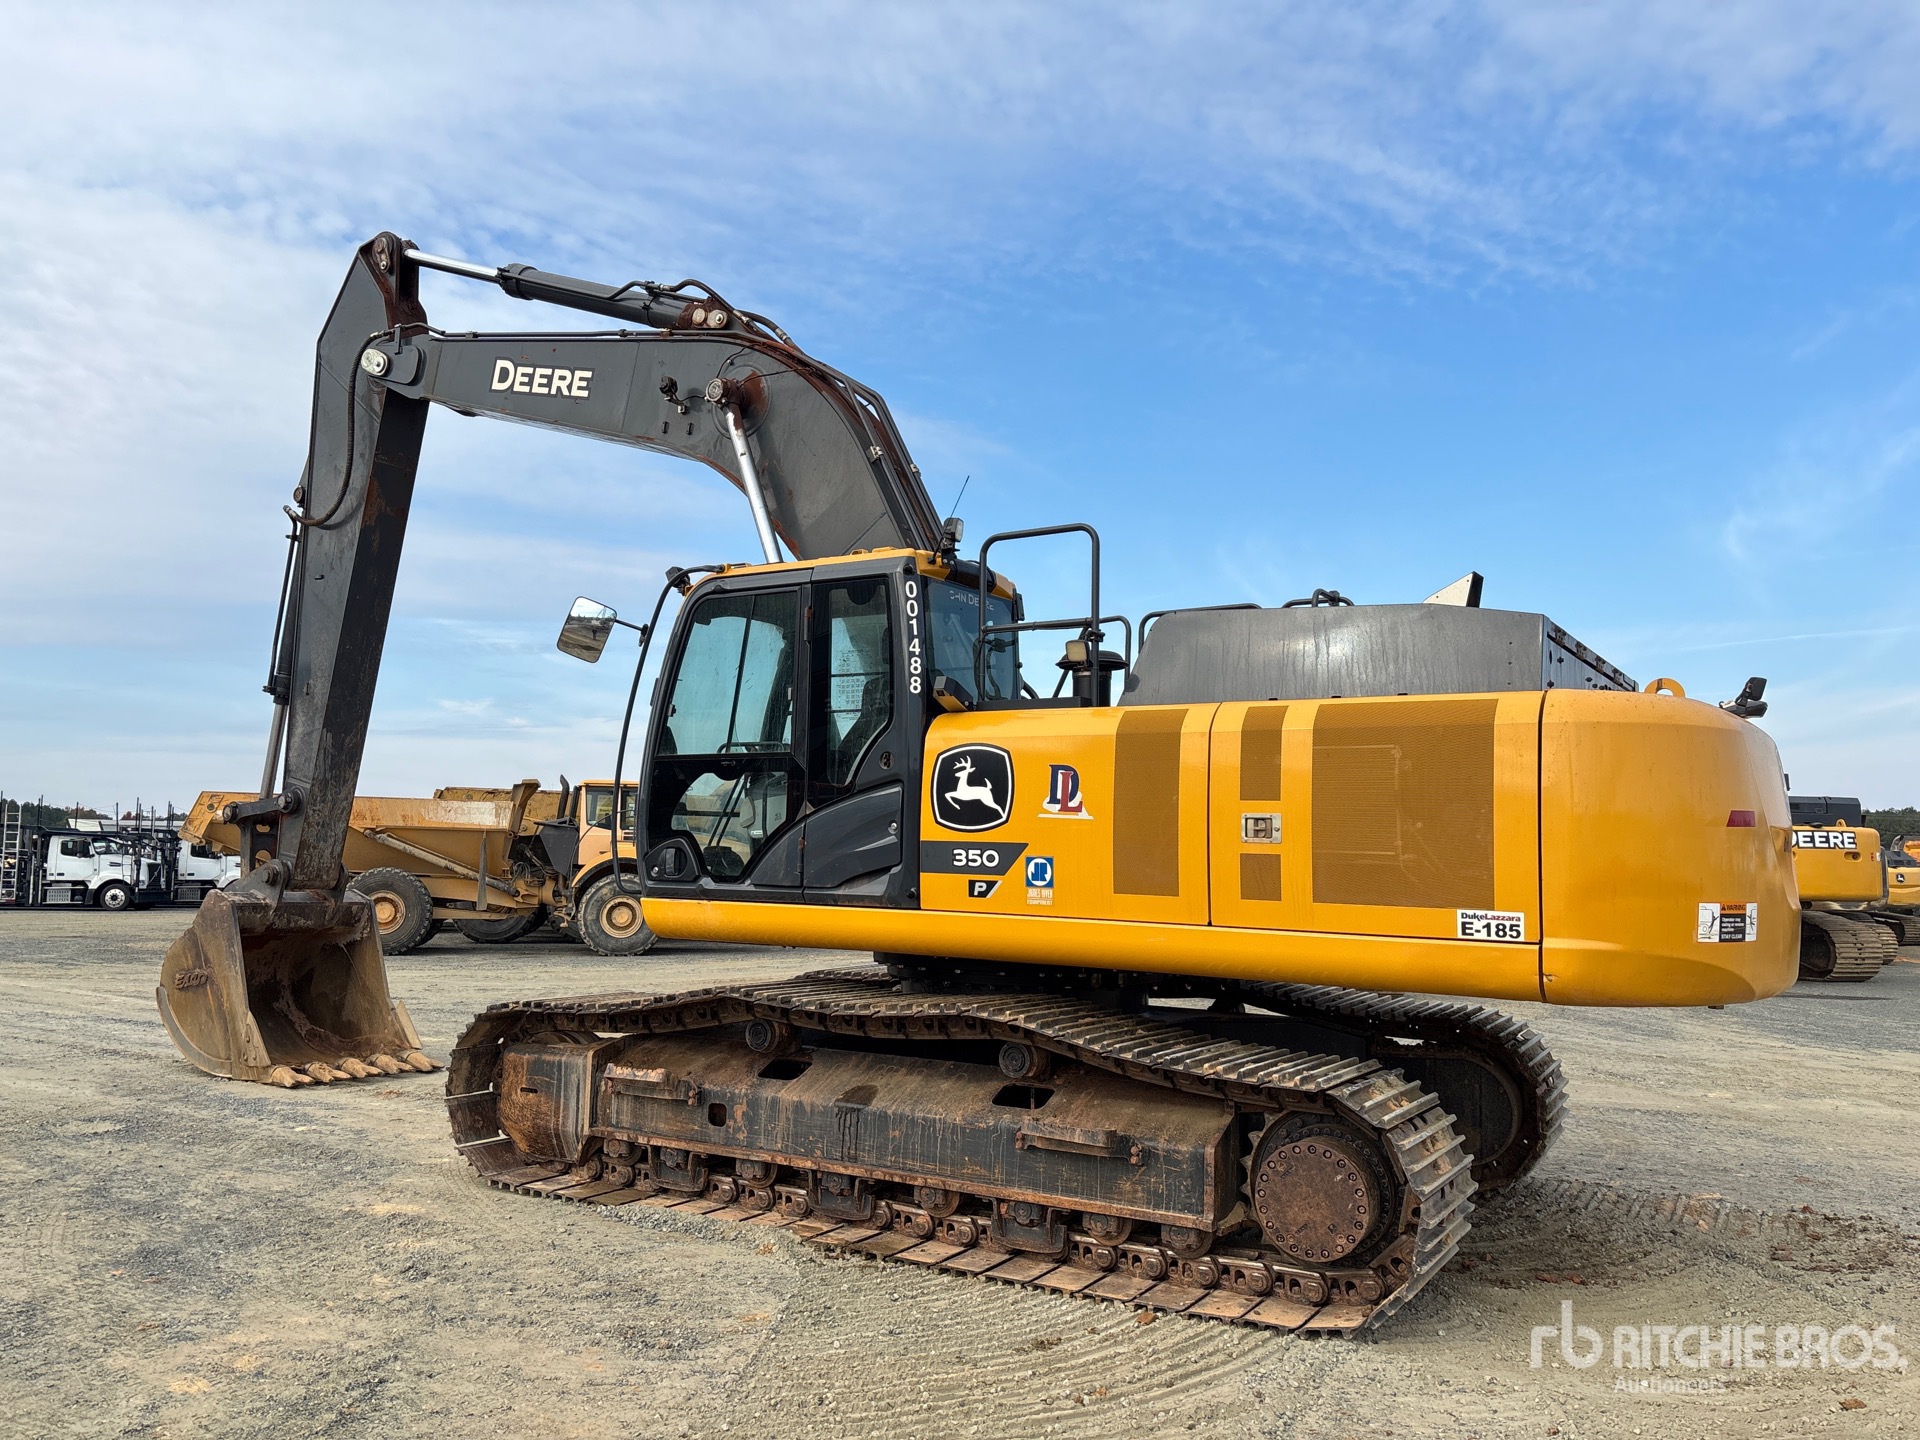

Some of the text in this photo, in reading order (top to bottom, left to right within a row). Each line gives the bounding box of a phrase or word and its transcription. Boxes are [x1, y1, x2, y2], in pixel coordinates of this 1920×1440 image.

[491, 359, 593, 397] DEERE
[968, 593, 995, 611] DERE
[905, 581, 921, 694] 001488
[953, 849, 999, 867] 350
[974, 882, 987, 895] P
[1461, 912, 1521, 921] DukeLazzara
[1461, 921, 1522, 939] E-185
